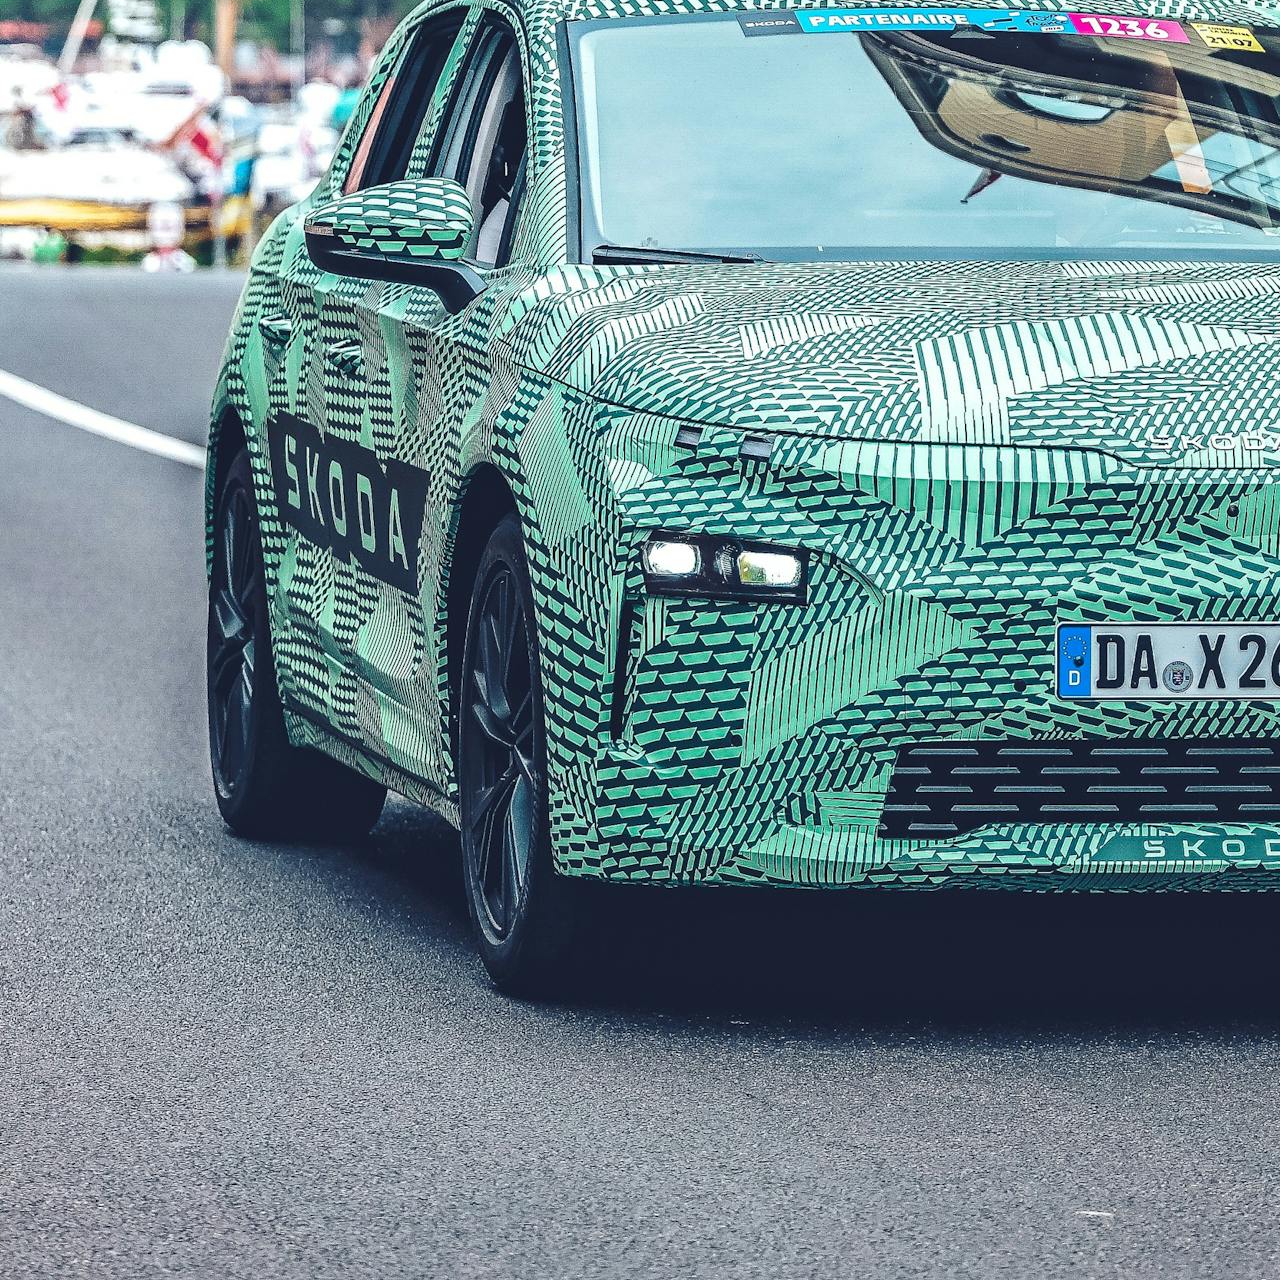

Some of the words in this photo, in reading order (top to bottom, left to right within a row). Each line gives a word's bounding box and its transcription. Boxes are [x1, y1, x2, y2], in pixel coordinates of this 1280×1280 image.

[808, 14, 970, 27] PARTENAIRE
[1080, 17, 1169, 39] 1236
[1096, 634, 1158, 689] DA
